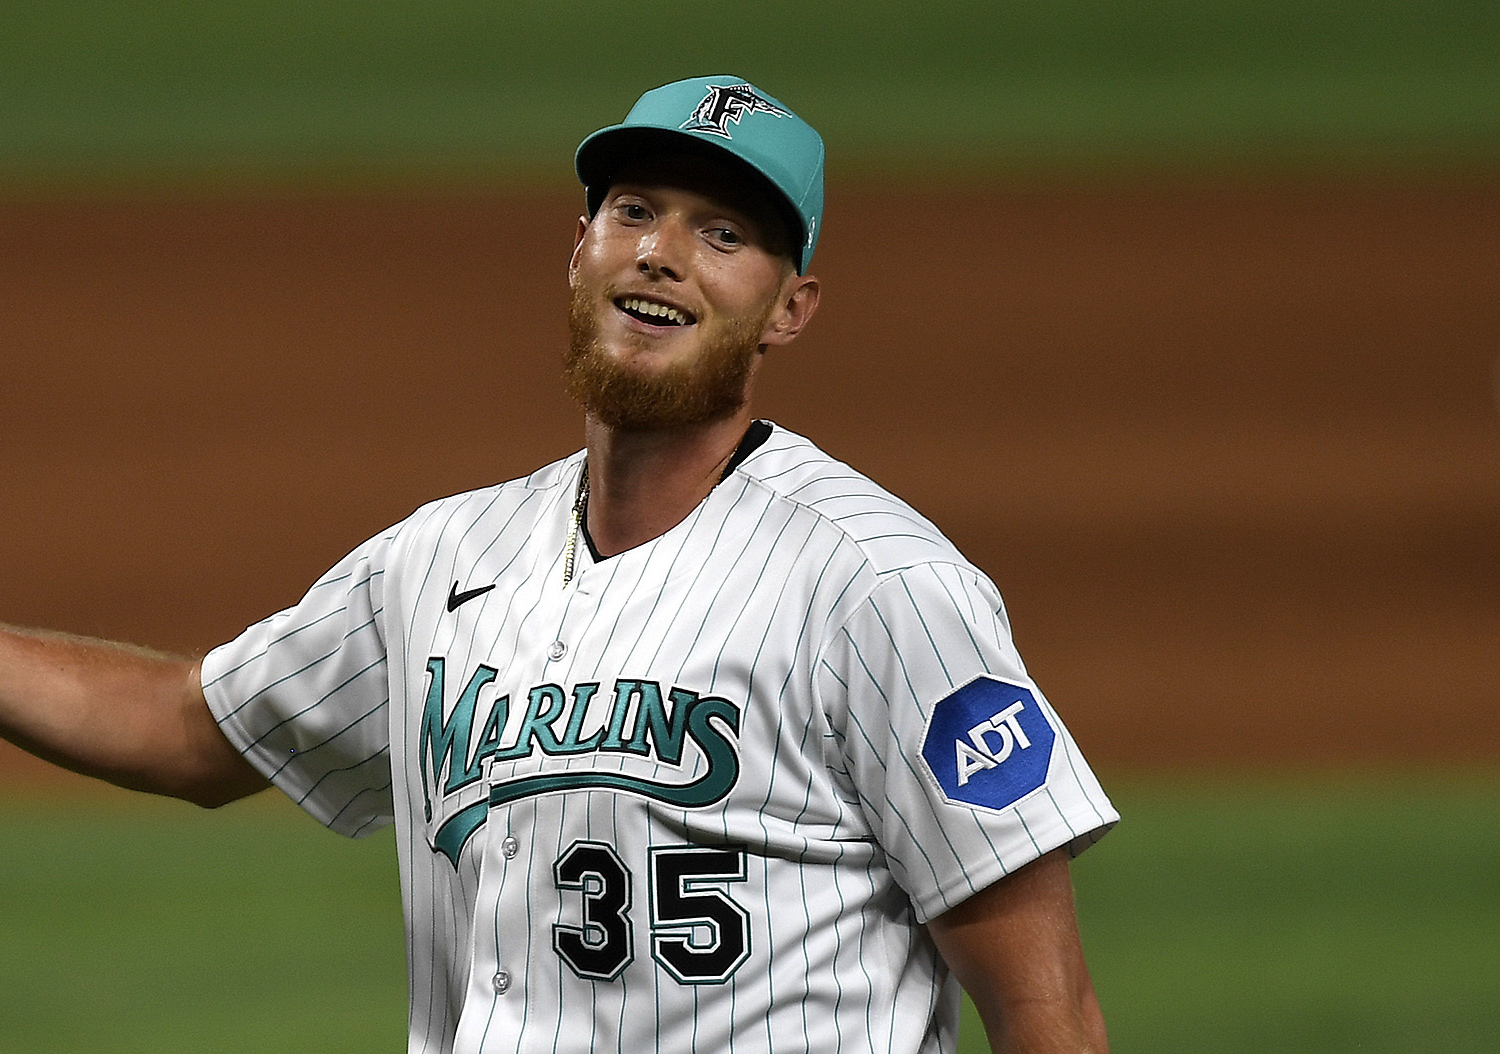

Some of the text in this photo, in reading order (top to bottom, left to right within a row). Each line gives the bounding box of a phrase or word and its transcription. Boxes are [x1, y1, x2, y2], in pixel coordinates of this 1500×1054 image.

[685, 84, 757, 139] F
[417, 655, 741, 822] MARLINS
[956, 700, 1028, 787] ADT
[552, 839, 752, 985] 35
